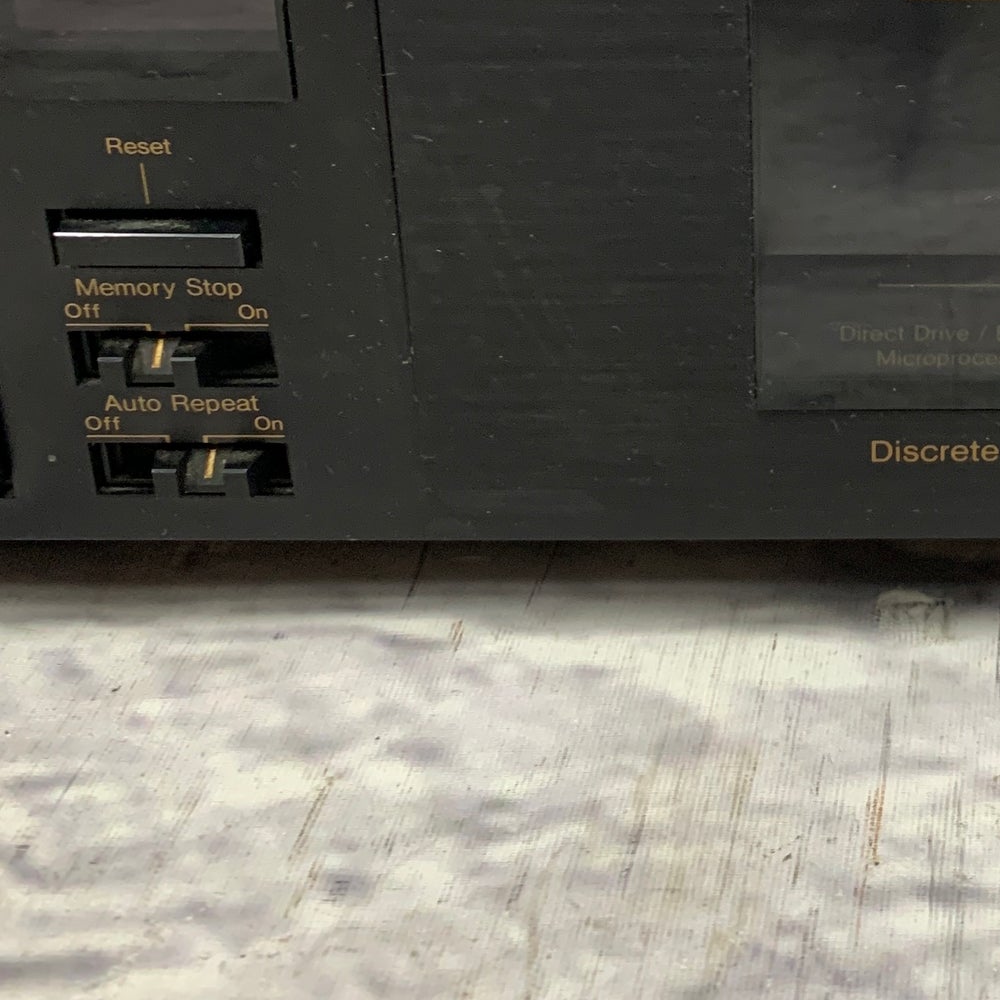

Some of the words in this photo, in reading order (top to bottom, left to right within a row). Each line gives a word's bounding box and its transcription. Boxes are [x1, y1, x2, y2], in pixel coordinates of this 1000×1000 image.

[105, 136, 173, 155] Reset
[75, 278, 175, 299] Memory
[186, 278, 243, 297] Stop
[64, 303, 100, 319] Off
[238, 304, 269, 320] On
[839, 324, 905, 343] Direct
[913, 325, 971, 343] Drive
[104, 395, 162, 413] Auto
[171, 395, 260, 415] Repeat
[84, 416, 121, 432] Off
[253, 417, 284, 432] On
[870, 440, 1000, 463] Discrete
